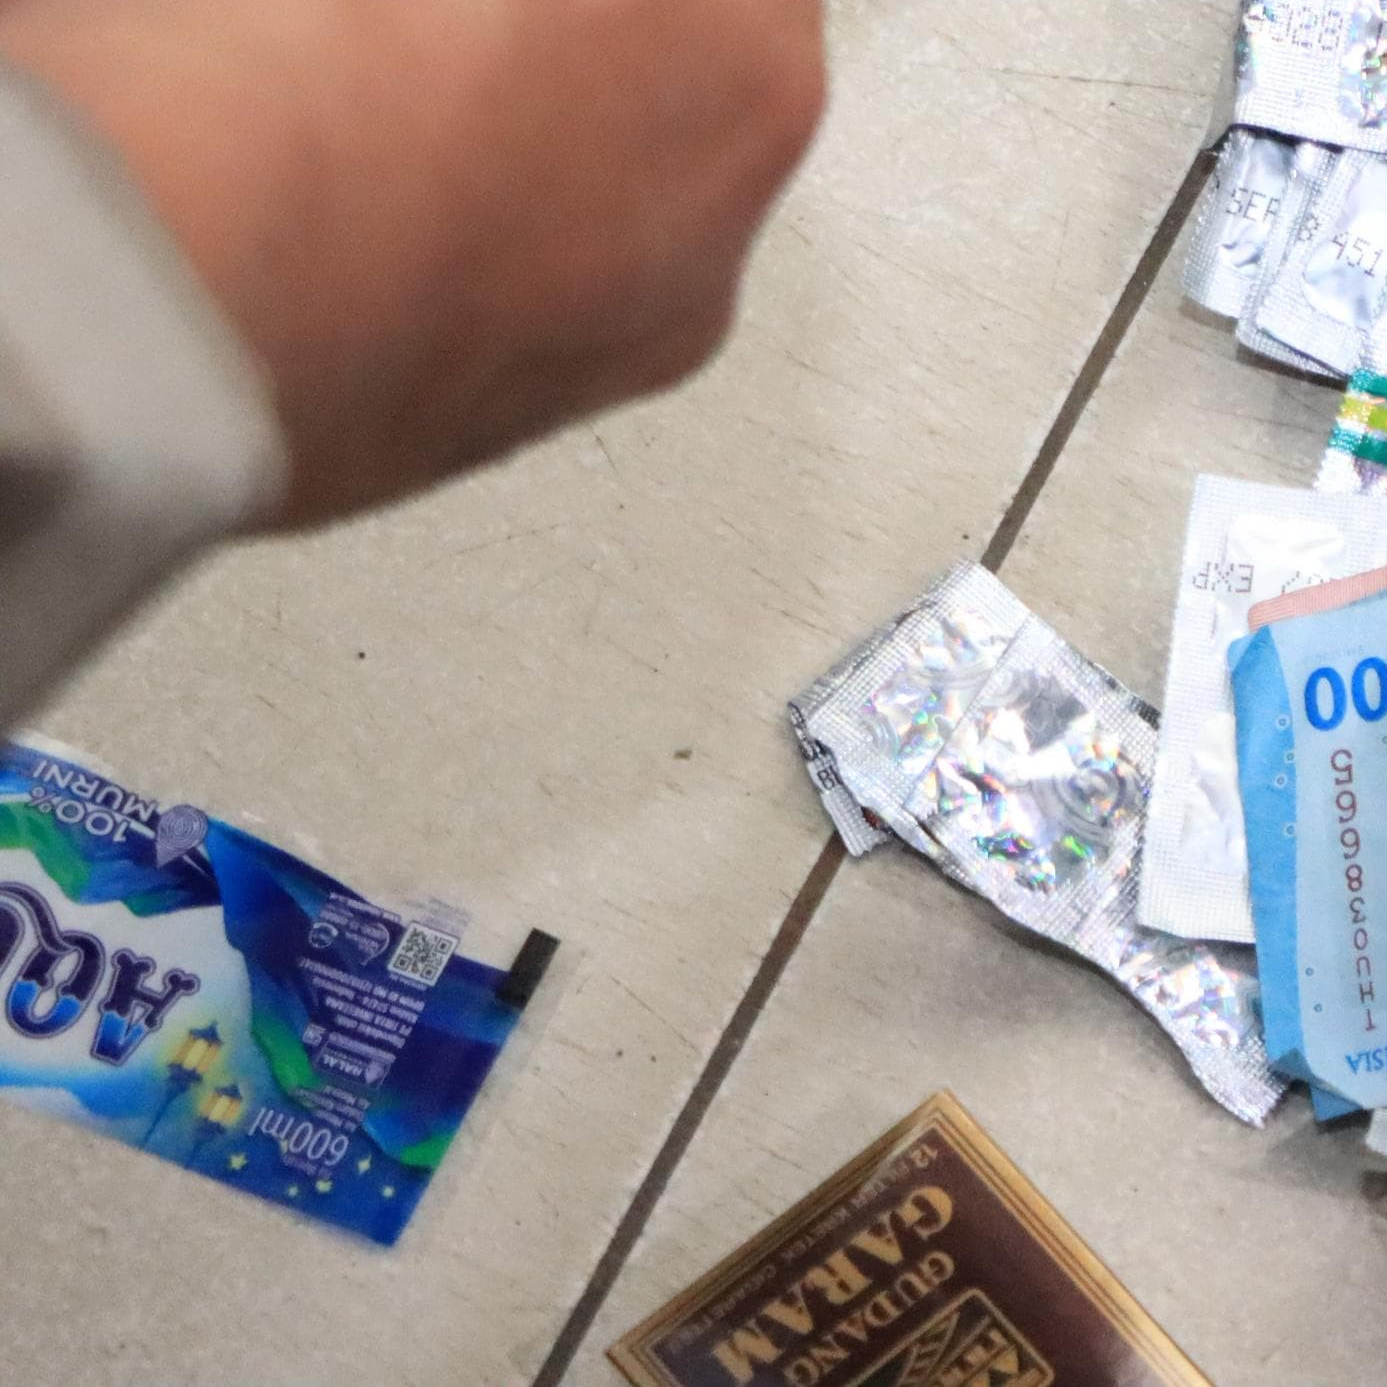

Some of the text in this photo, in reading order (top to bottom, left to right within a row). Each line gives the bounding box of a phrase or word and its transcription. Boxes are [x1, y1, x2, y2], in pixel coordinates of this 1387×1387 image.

[1191, 561, 1253, 592] EXP
[29, 785, 132, 843] 100%
[35, 759, 157, 821] MURNI
[248, 1107, 350, 1163] 600ml
[908, 1140, 939, 1169] 12
[711, 1184, 955, 1385] GARAM
[783, 1250, 956, 1387] GUDANG
